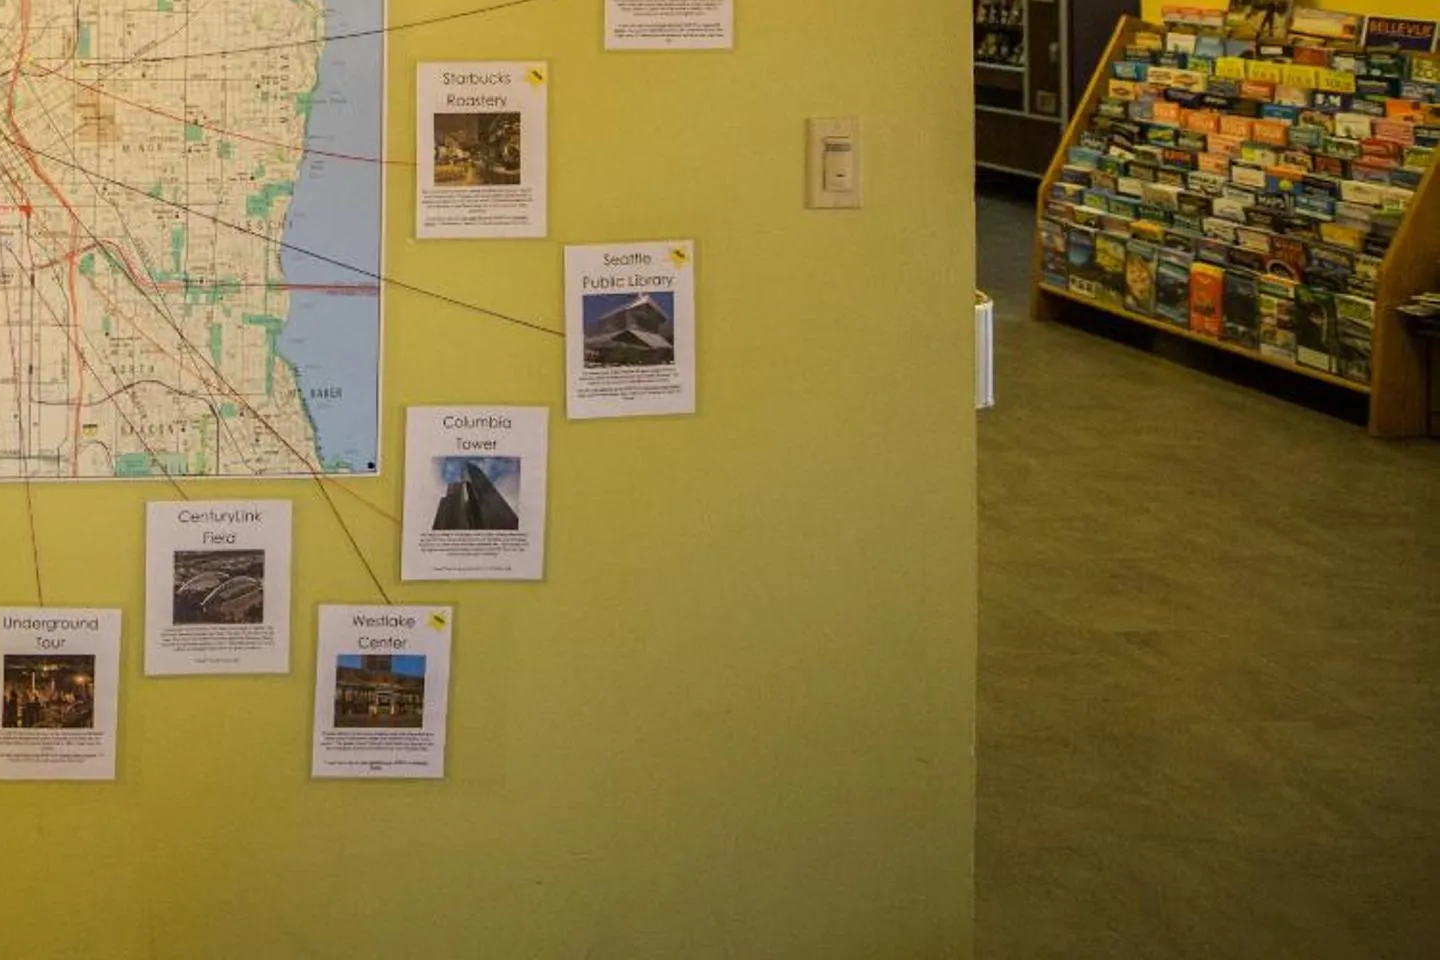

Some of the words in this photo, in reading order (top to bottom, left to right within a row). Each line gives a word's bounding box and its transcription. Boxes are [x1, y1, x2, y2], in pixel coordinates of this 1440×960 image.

[443, 72, 511, 85] Starbucks
[447, 94, 507, 108] Roastery
[603, 253, 652, 266] Seattle
[583, 276, 625, 289] Public
[628, 274, 674, 287] Library
[443, 416, 511, 429] Columbia
[456, 438, 497, 450] Tower
[178, 510, 262, 523] CenturyLink
[203, 532, 236, 544] Field
[3, 616, 99, 632] Underground
[352, 615, 416, 628] Westlake
[37, 637, 66, 649] Tour
[359, 637, 407, 649] Center
